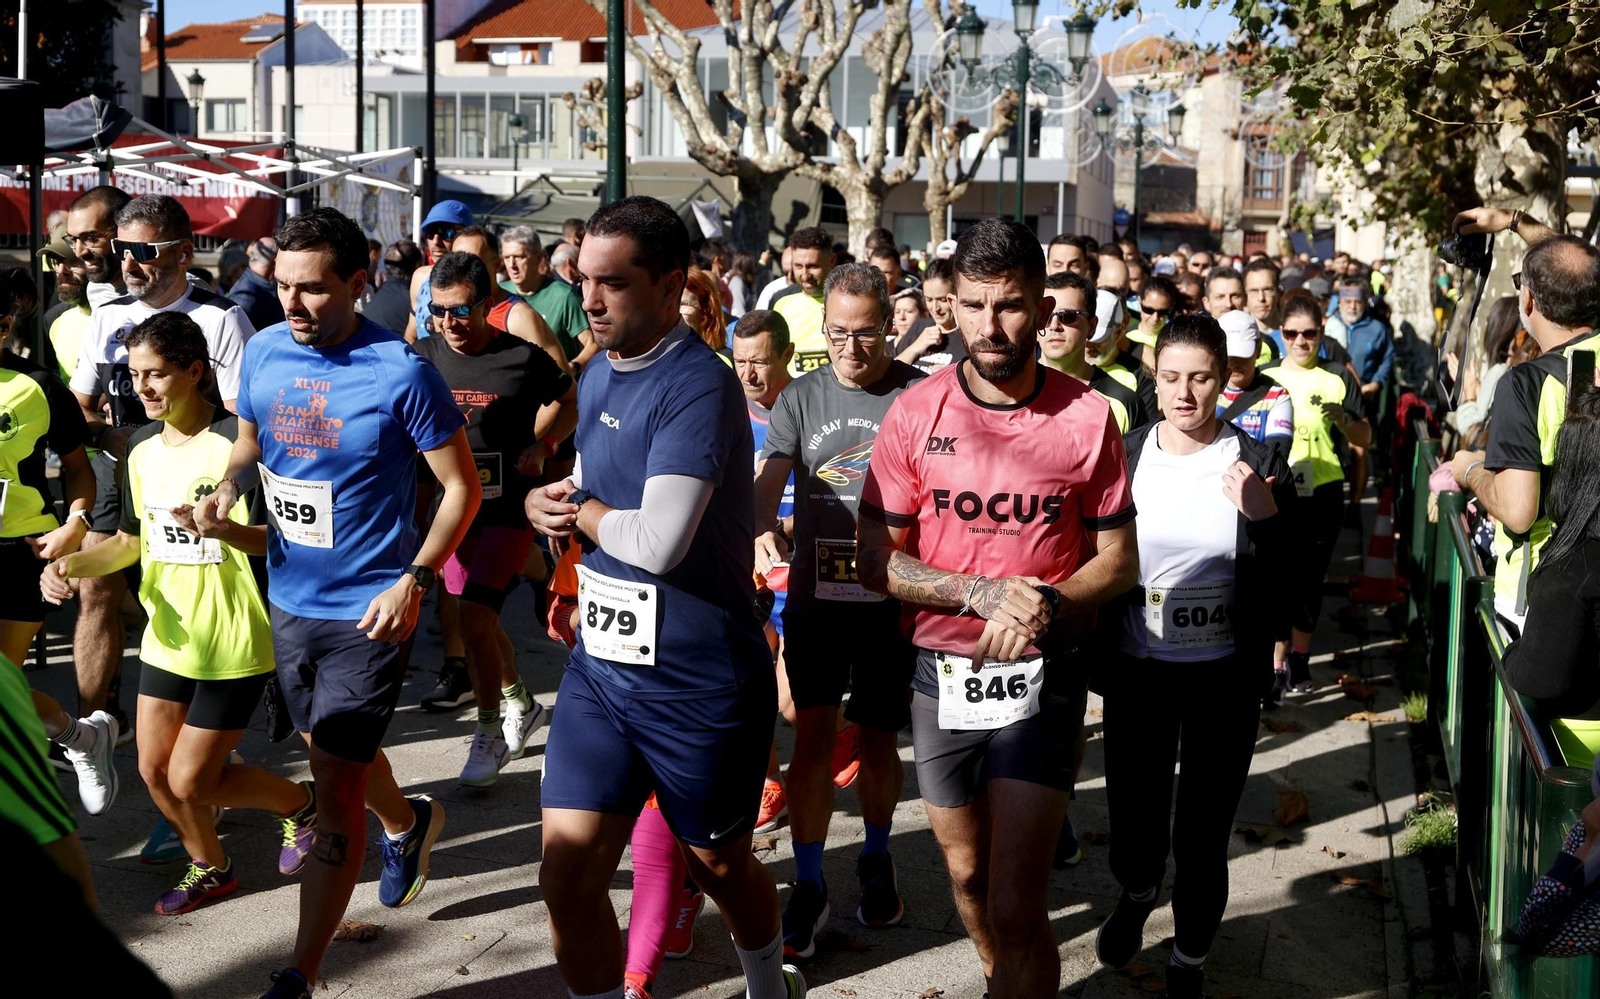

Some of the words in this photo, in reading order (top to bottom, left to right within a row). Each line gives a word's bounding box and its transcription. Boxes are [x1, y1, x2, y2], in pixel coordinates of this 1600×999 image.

[294, 377, 331, 392] XLVII
[466, 393, 493, 402] CARES
[277, 404, 307, 418] SAN
[273, 432, 339, 449] OURENSE
[808, 418, 841, 451] VIG-BAY
[847, 418, 872, 429] MEDIO
[927, 436, 959, 452] DK
[286, 446, 317, 460] 2024
[273, 495, 317, 525] 859
[932, 488, 1065, 524] FOCUS
[968, 527, 997, 535] TRAINING
[999, 528, 1021, 536] STUDIO
[587, 600, 637, 636] 879
[1172, 604, 1226, 628] 604
[964, 673, 1028, 703] 846
